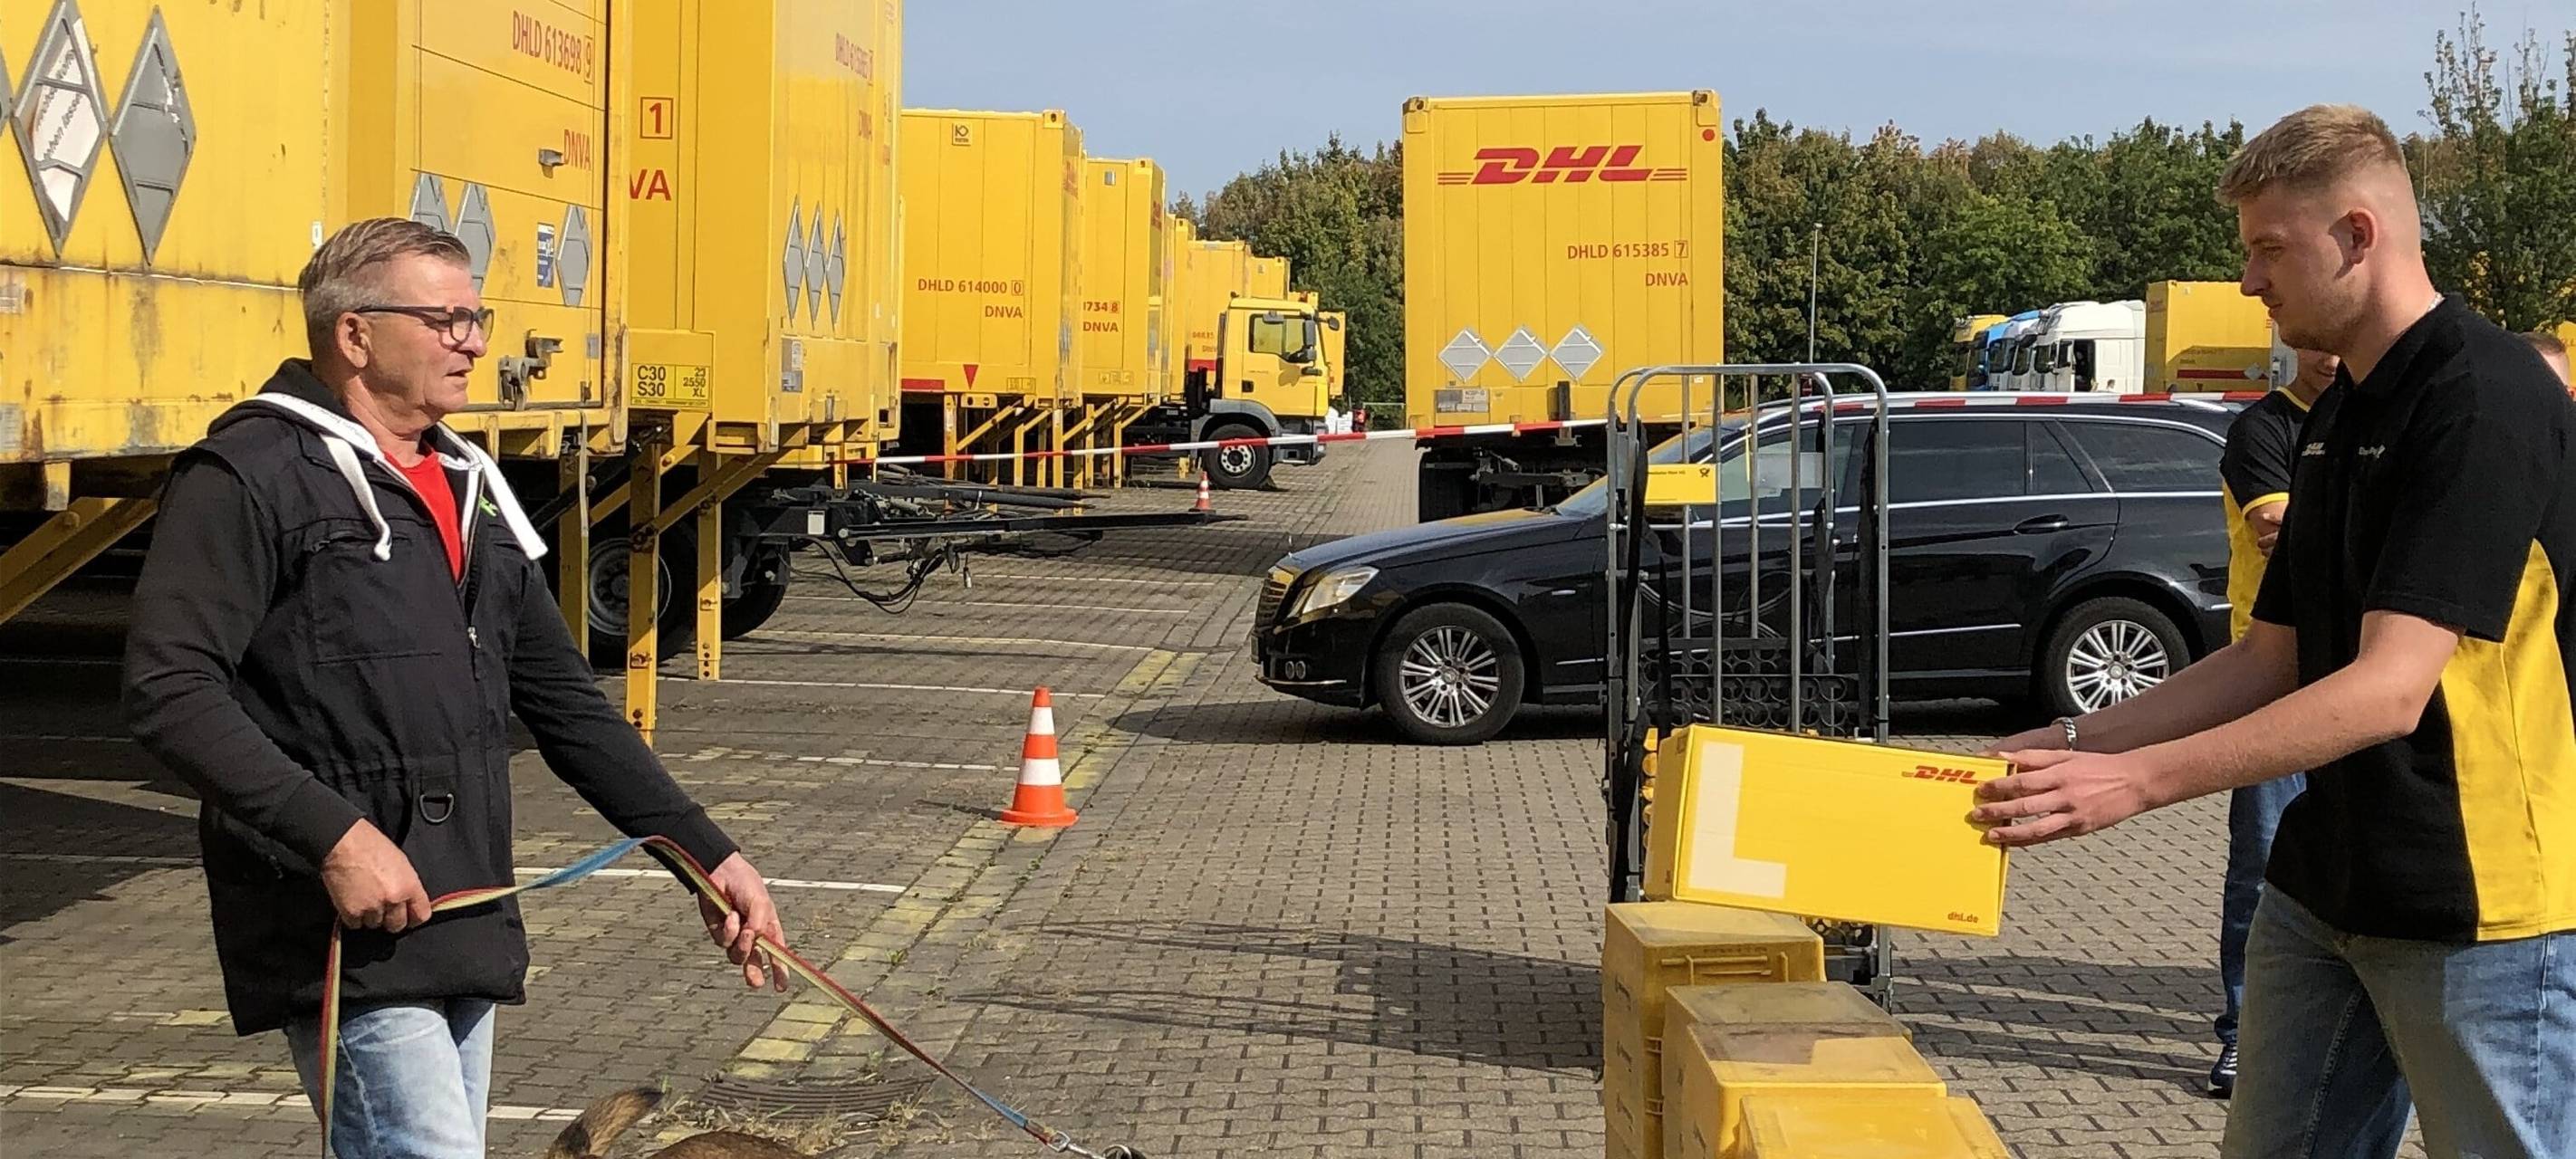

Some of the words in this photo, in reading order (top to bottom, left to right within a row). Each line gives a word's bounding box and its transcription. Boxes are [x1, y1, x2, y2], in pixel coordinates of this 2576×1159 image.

[513, 10, 542, 58] DHLD
[545, 24, 582, 74] 613698
[585, 40, 593, 80] 9
[649, 101, 662, 134] 1
[563, 129, 591, 171] DNVA
[1471, 145, 1653, 185] DHL
[1568, 244, 1609, 259] DHLD
[1612, 243, 1668, 258] 615385
[1676, 241, 1687, 257] 7
[918, 278, 955, 292] DHLD
[958, 280, 1007, 294] 614000
[1645, 273, 1688, 287] DNVA
[985, 305, 1024, 319] DNVA
[1082, 321, 1119, 332] DNVA
[638, 365, 667, 381] C30
[638, 381, 665, 397] S30
[692, 388, 706, 398] XL
[1914, 765, 1978, 785] DHL
[1687, 740, 1787, 899] L
[1947, 912, 1979, 924] dhl.de
